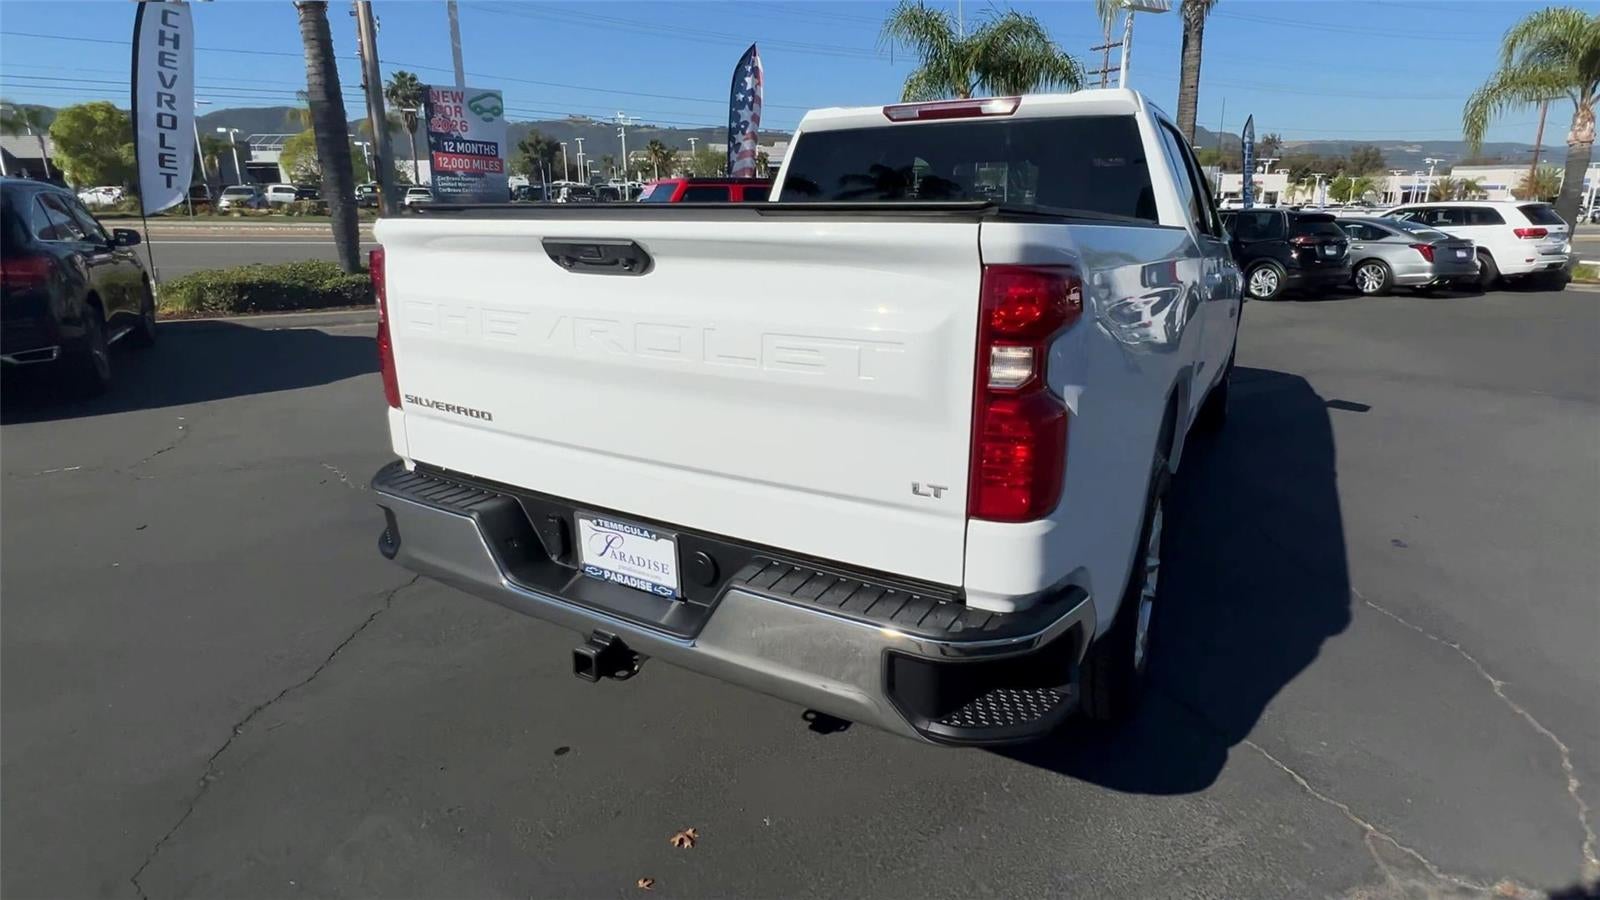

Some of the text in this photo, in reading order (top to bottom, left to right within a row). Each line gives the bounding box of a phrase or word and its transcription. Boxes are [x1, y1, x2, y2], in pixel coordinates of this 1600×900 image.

[156, 9, 180, 188] CHEVROLET
[432, 90, 464, 104] NEW
[434, 104, 463, 118] FOR
[432, 118, 468, 133] 2026
[443, 141, 497, 155] 12 MONTHS
[438, 156, 500, 171] 12,000 MILES
[402, 299, 906, 382] CHEVROLET
[405, 393, 493, 422] SILVERADO
[911, 481, 948, 499] LT
[598, 519, 651, 538] TEMECULA
[589, 526, 670, 575] PARADISE
[604, 569, 653, 592] PARADISE
